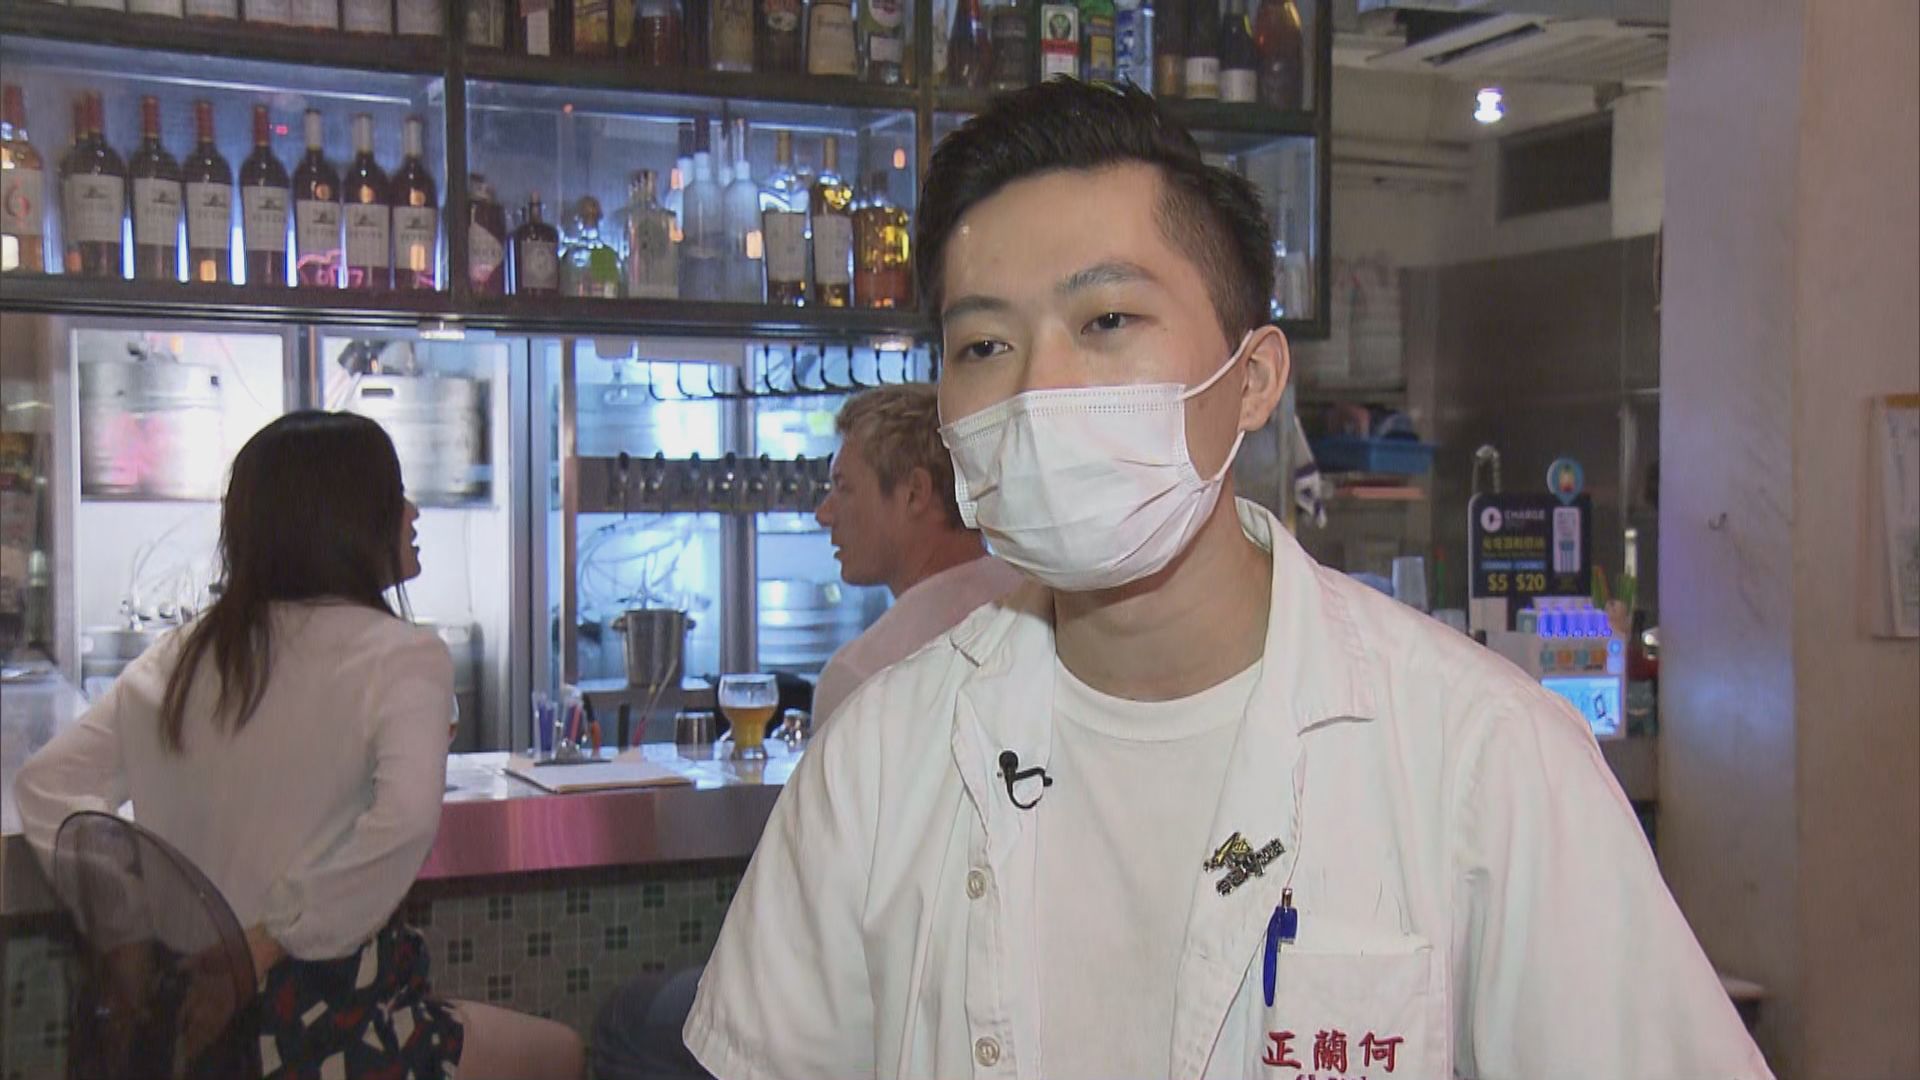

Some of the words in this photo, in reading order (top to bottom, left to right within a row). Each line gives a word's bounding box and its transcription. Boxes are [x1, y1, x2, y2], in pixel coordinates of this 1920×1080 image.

[1504, 509, 1545, 521] CHARGE
[1488, 573, 1508, 592] $5
[1516, 573, 1546, 592] $20
